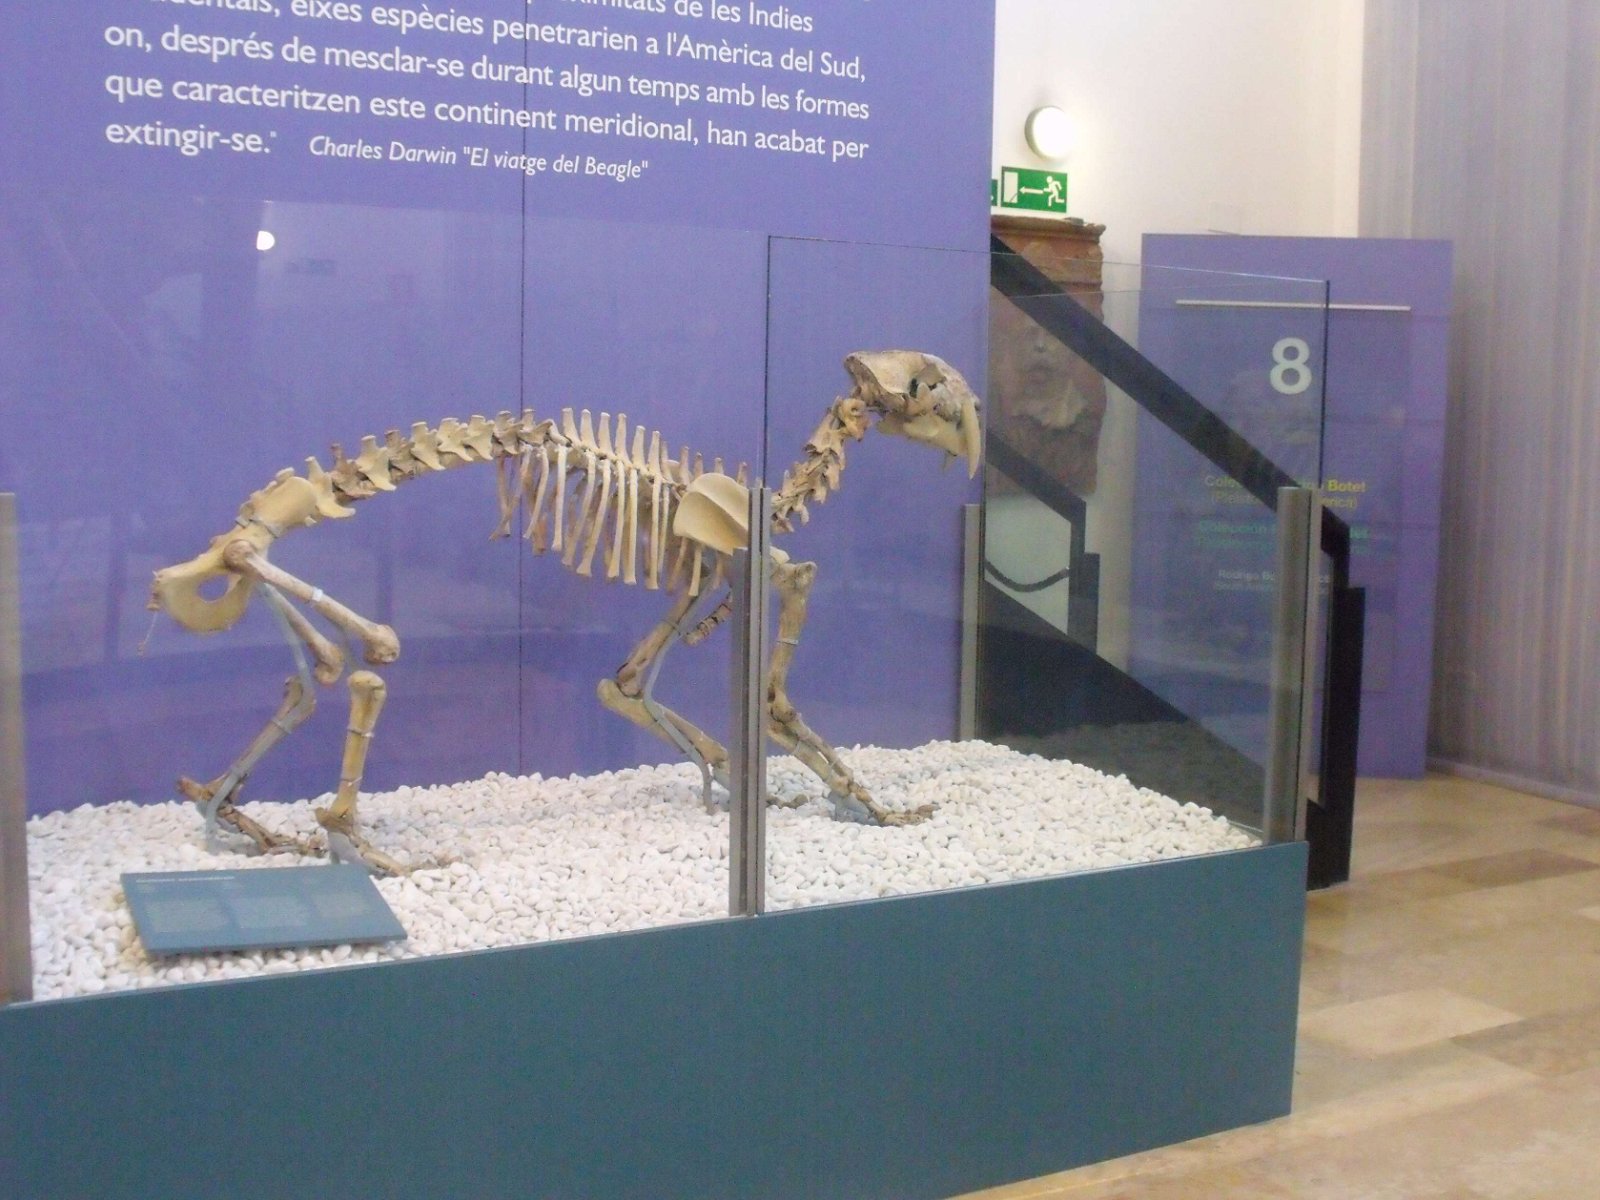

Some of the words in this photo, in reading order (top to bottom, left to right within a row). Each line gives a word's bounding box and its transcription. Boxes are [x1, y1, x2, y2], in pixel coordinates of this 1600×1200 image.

[290, 0, 363, 23] eixes
[370, 4, 484, 36] espècies
[492, 19, 638, 52] penetrarien
[645, 37, 660, 55] a
[666, 31, 774, 69] l'Amèrica
[780, 47, 814, 73] del
[820, 51, 866, 83] Sud,
[673, 0, 703, 18] de
[711, 0, 741, 23] les
[749, 1, 813, 33] Indies
[104, 25, 152, 53] on,
[160, 24, 274, 63] després
[281, 36, 317, 64] de
[324, 46, 465, 78] mesclar-se
[471, 55, 554, 87] durant
[559, 63, 622, 97] algun
[627, 74, 700, 107] temps
[706, 82, 755, 107] amb
[761, 85, 790, 111] les
[795, 88, 870, 120] formes
[104, 74, 163, 104] que
[171, 80, 361, 114] caracteritzen
[369, 96, 426, 119] este
[434, 102, 557, 130] continent
[564, 112, 699, 146] meridional,
[707, 119, 748, 148] han
[754, 128, 826, 155] acabat
[832, 140, 870, 163] per
[309, 135, 383, 160] Charles
[388, 140, 457, 165] Darwin
[463, 146, 489, 167] "El
[493, 150, 547, 176] viatge
[552, 153, 580, 174] del
[584, 155, 649, 183] Beagle"
[1270, 337, 1312, 395] 8
